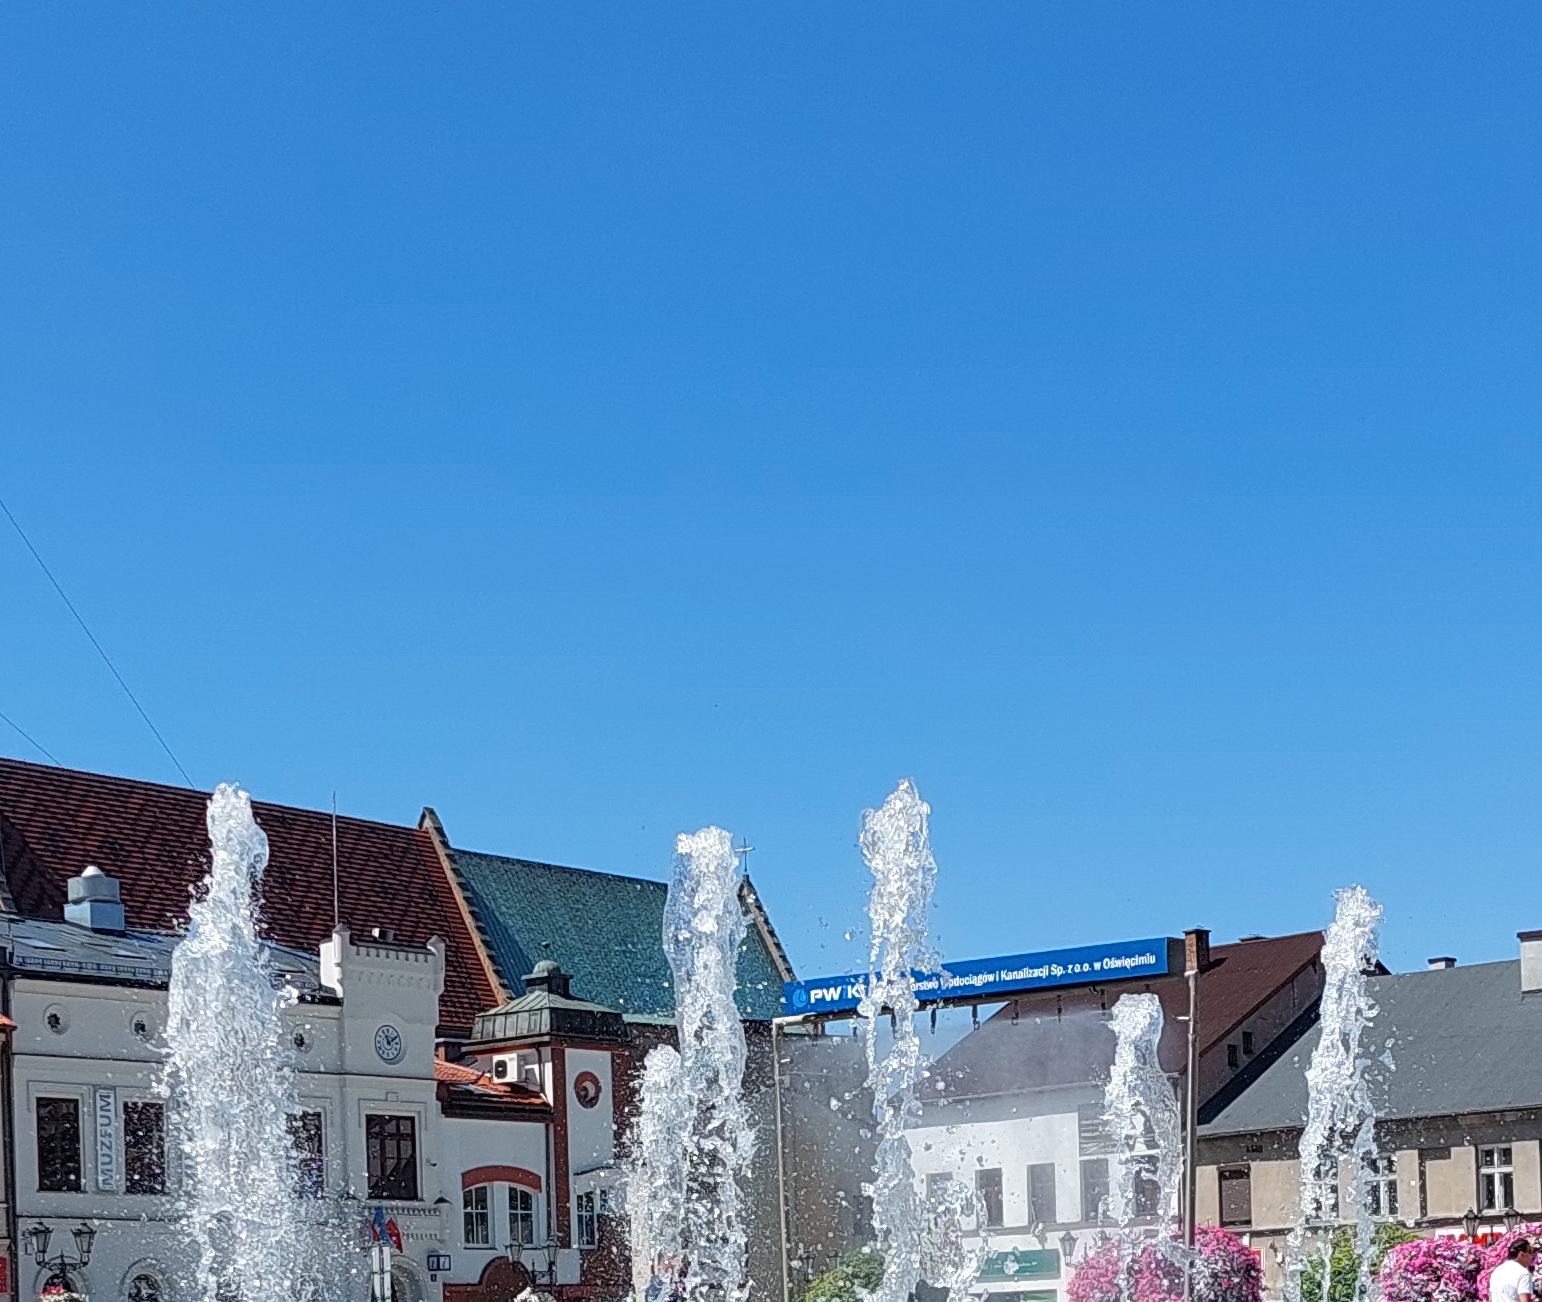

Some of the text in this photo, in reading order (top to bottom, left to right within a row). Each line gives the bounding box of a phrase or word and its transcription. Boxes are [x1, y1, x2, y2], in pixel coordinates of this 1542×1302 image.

[939, 970, 995, 991] odociągów
[1001, 965, 1049, 982] Kanalizacji
[1093, 960, 1102, 971] w
[1102, 953, 1156, 971] Oświęcimiu
[99, 1093, 114, 1187] MUZEUM
